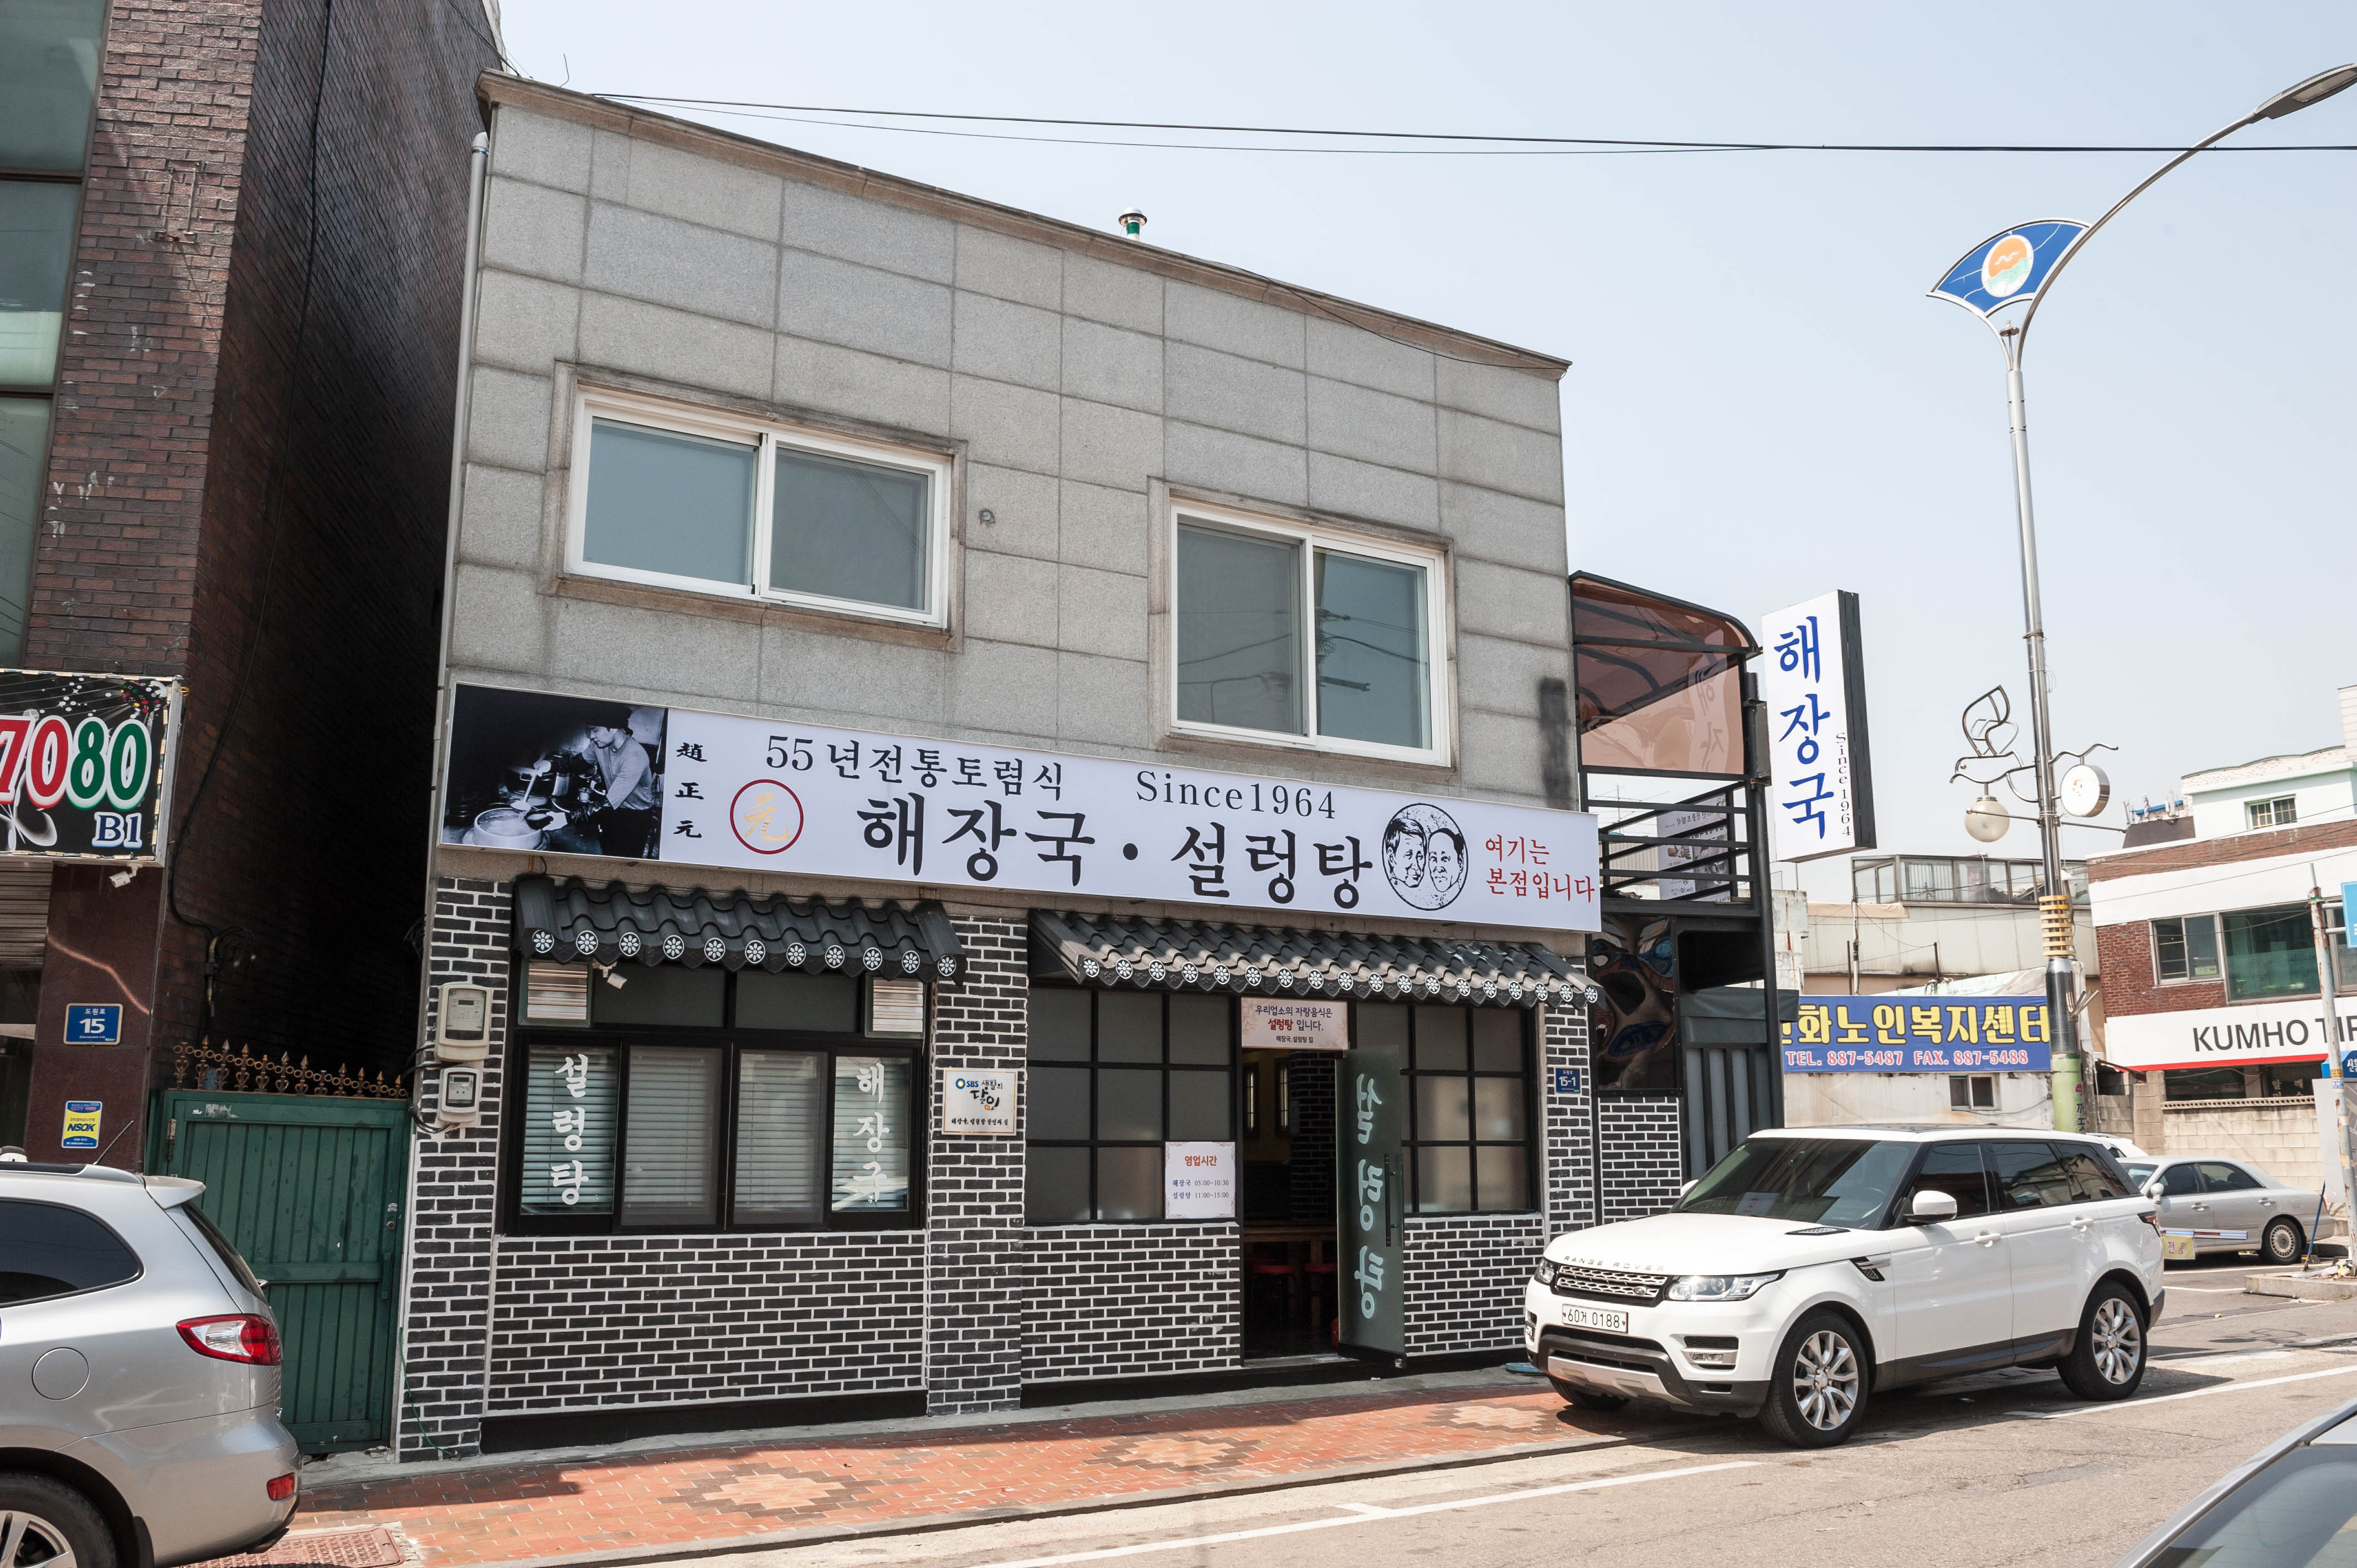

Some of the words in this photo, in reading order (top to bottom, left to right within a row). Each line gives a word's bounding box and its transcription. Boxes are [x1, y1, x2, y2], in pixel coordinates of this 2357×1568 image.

[1774, 616, 1834, 839] 해장국
[0, 715, 152, 811] 7080
[92, 812, 142, 848] B1
[1485, 833, 1549, 863] 여기는
[1485, 868, 1596, 903] 본점입니다
[1255, 1004, 1293, 1016] 우리업소의
[1295, 1007, 1333, 1018] 자랑음식은
[79, 1018, 105, 1034] 15
[1268, 1018, 1293, 1031] 설렁탕
[1296, 1019, 1324, 1031] 입니다.
[1782, 1005, 2050, 1045] 화노인복지센터
[2193, 1019, 2309, 1052] KUMHO
[1786, 1051, 1821, 1065] TEL.
[1828, 1051, 1903, 1065] 887-5487
[1914, 1051, 1949, 1065] FAX.
[1954, 1050, 2028, 1065] 887-5488
[1559, 1076, 1576, 1086] 15-1
[970, 1089, 1000, 1111] 달인
[67, 1123, 96, 1132] NSOK
[550, 1054, 589, 1205] 설렁탕
[853, 1062, 889, 1203] 해장국
[1185, 1155, 1217, 1167] 영업시간
[1564, 1256, 1604, 1266] RANGE
[1613, 1262, 1664, 1271] ROVER
[1567, 1308, 1587, 1323] 60거
[1592, 1312, 1620, 1328] 0188
